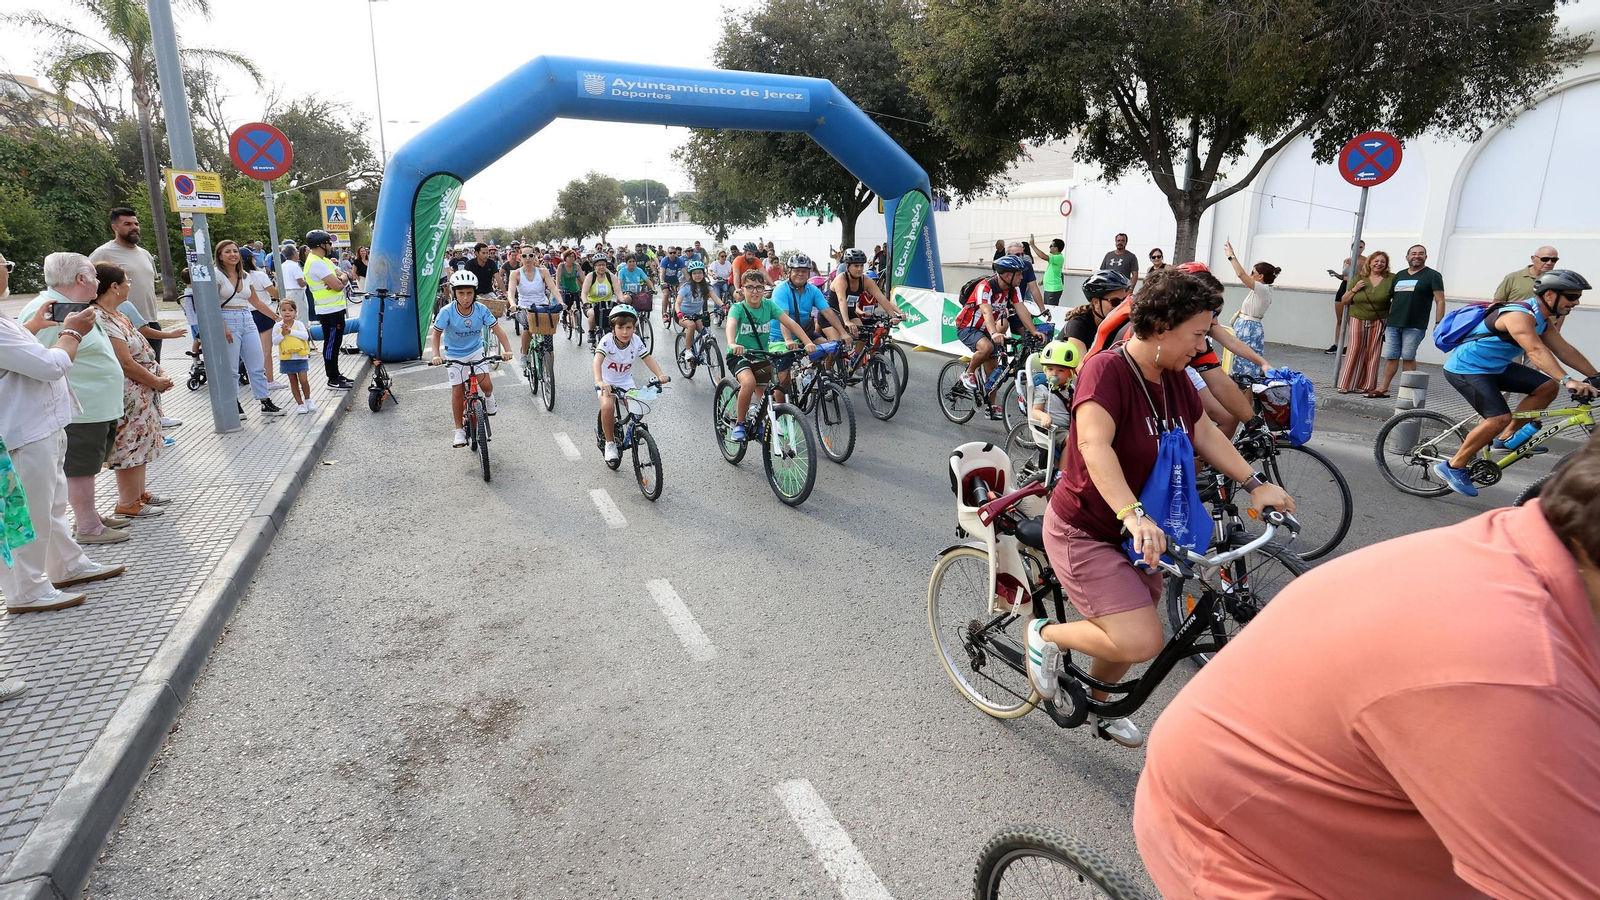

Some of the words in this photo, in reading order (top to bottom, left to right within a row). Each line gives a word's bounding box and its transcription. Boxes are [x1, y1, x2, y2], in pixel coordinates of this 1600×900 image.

[611, 77, 737, 96] Ayuntamiento
[740, 88, 759, 97] de
[763, 89, 803, 100] Jerez
[611, 88, 672, 100] Deportes
